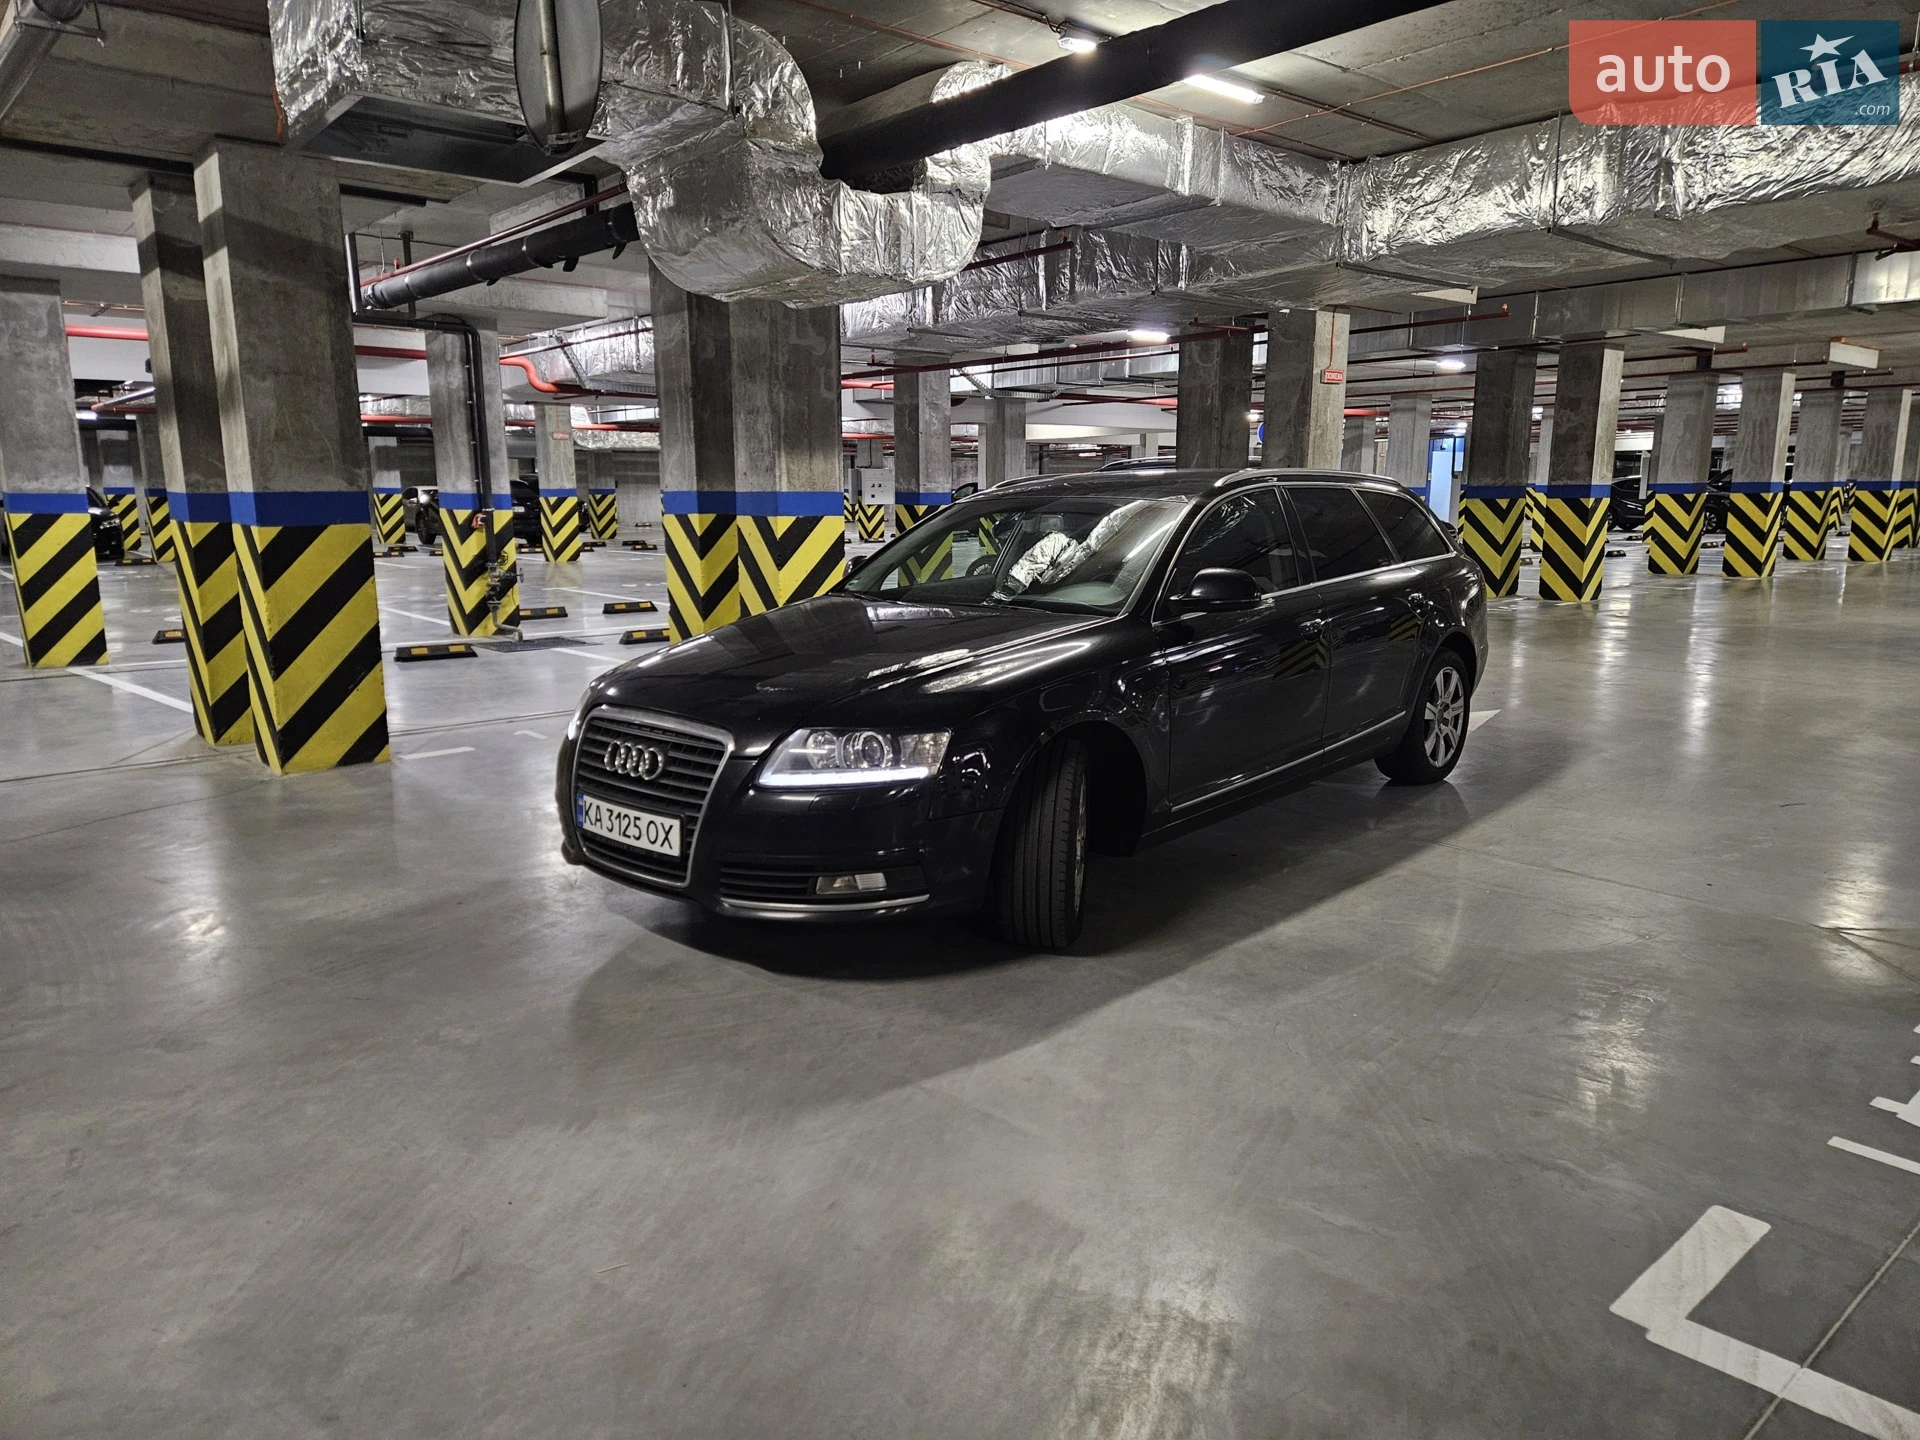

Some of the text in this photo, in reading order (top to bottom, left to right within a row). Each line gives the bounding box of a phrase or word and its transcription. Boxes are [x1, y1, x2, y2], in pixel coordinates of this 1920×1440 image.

[584, 800, 602, 830] KA
[606, 808, 641, 841] 3125
[646, 820, 674, 850] OX
